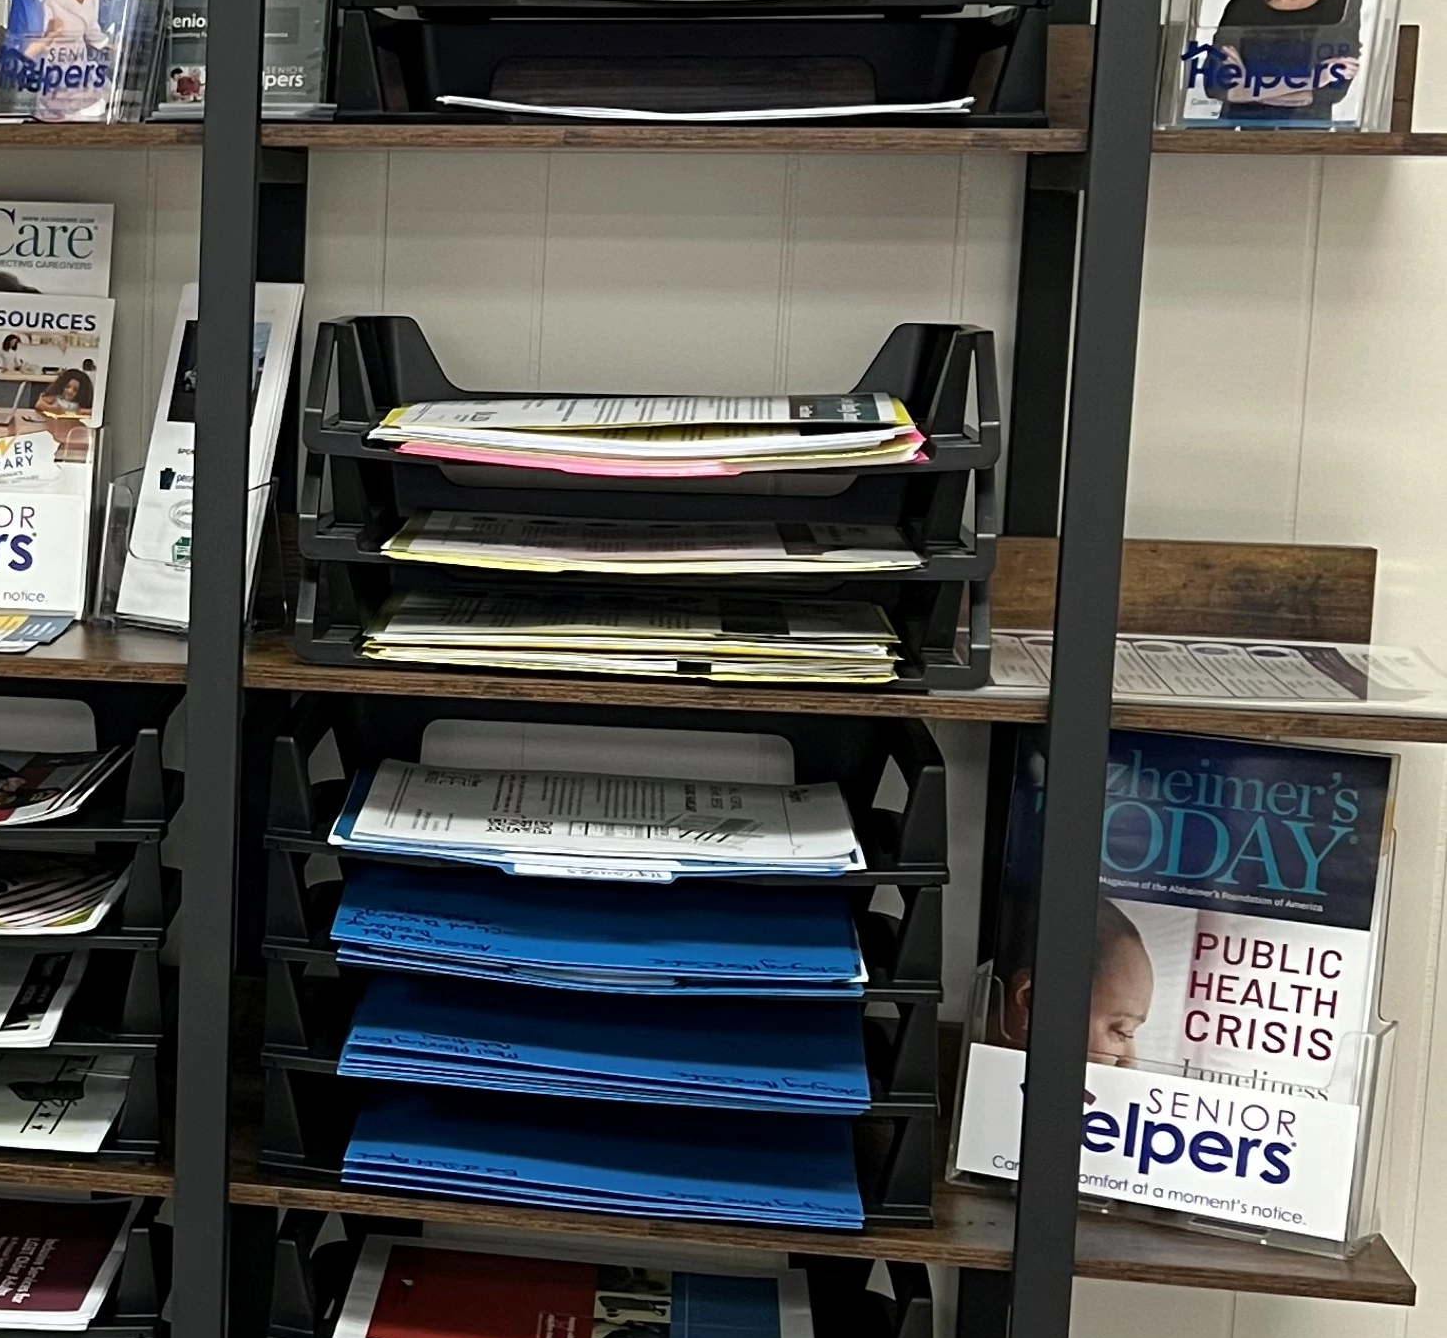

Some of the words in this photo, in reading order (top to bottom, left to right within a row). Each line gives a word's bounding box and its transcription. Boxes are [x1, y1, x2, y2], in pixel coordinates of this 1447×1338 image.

[3, 590, 48, 603] notice.
[1106, 750, 1359, 823] zheimer's
[1101, 801, 1354, 895] ODAY
[1141, 882, 1152, 890] of
[1153, 884, 1167, 892] the
[1168, 885, 1220, 898] Alzheimer's
[1222, 891, 1272, 905] Foundation
[1275, 898, 1284, 906] of
[1286, 900, 1323, 912] America
[1195, 933, 1342, 980] PUBLIC
[1189, 972, 1338, 1019] HEALTH
[1184, 1010, 1332, 1060] CRISIS
[1147, 1088, 1295, 1137] SENIOR
[1082, 1104, 1292, 1185] elpers
[1133, 1180, 1149, 1195] at
[1153, 1187, 1164, 1199] a
[1168, 1188, 1247, 1215] moment's
[1251, 1204, 1307, 1226] notice.
